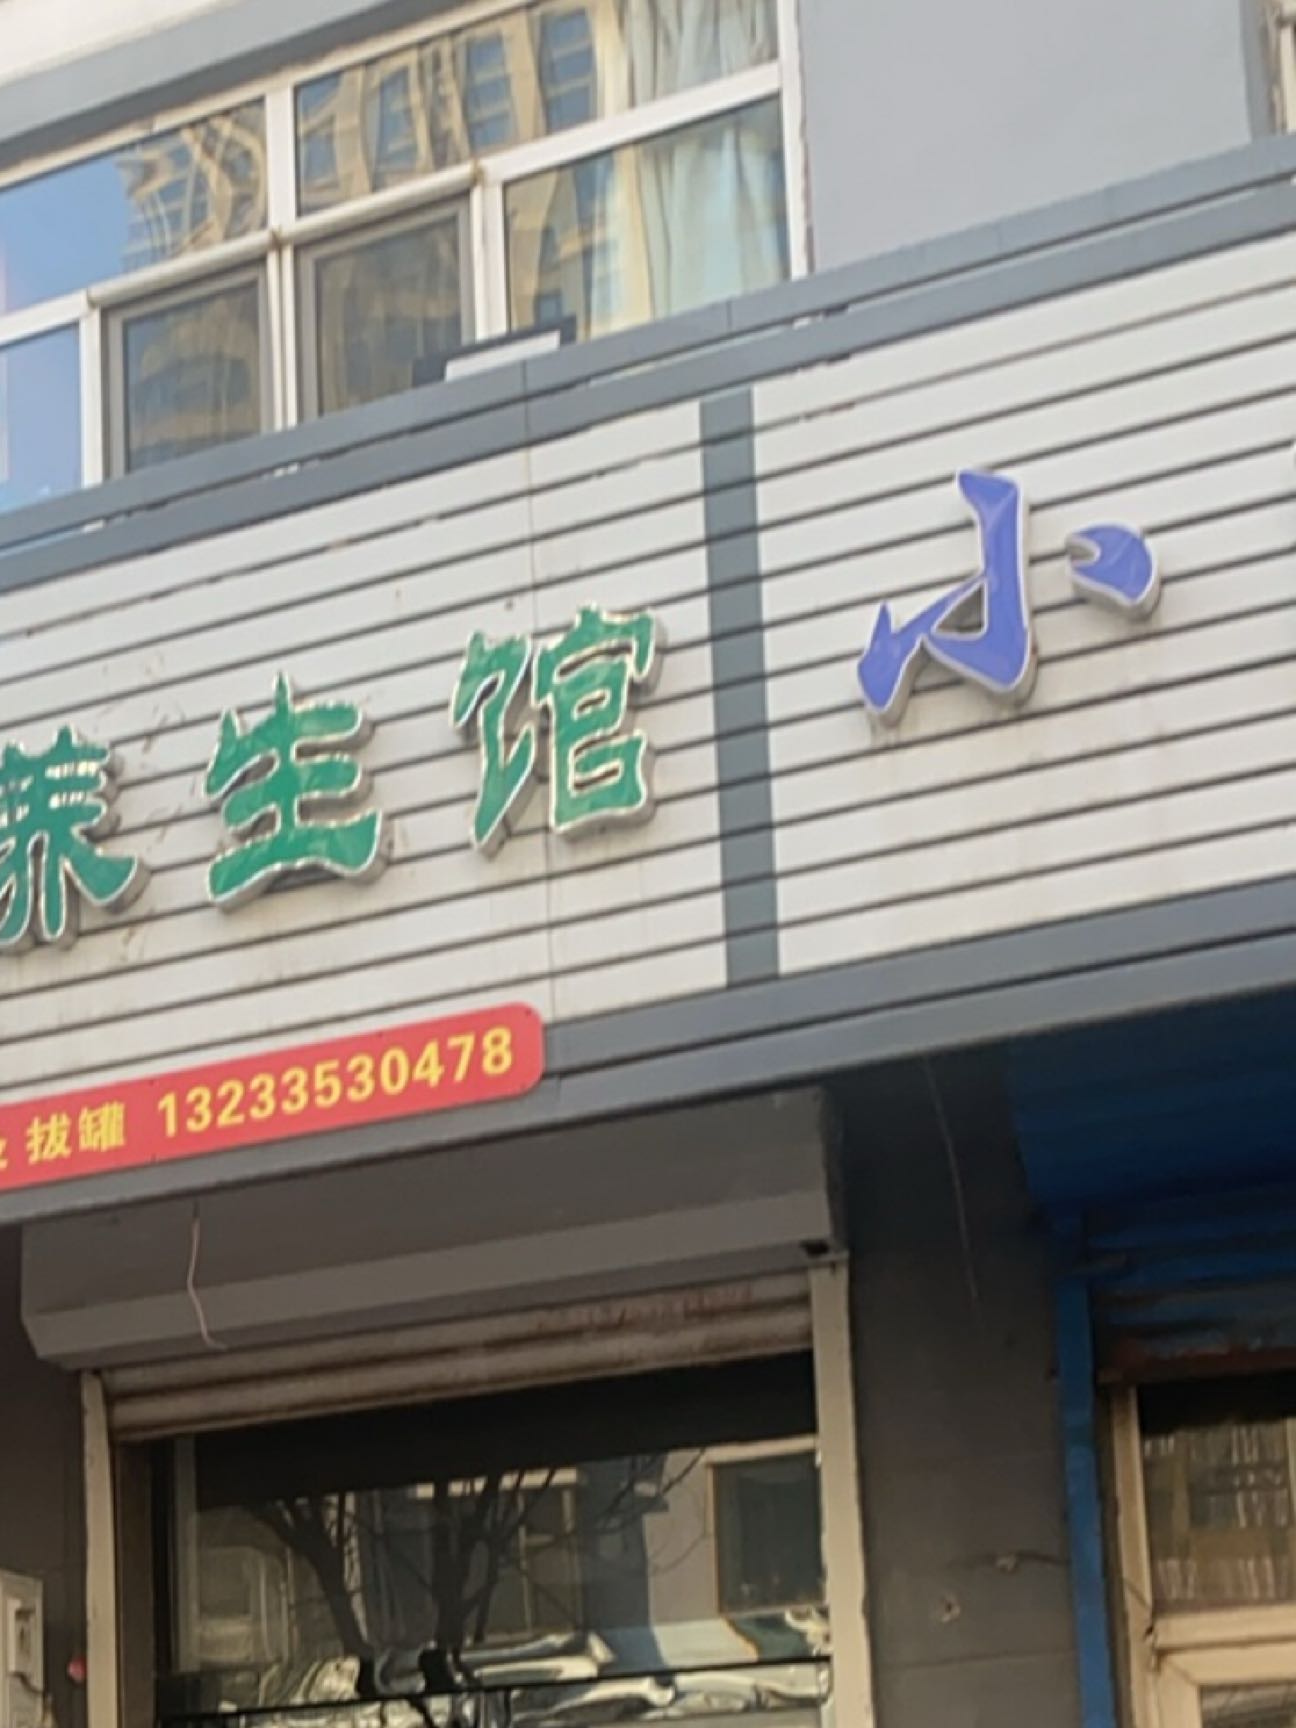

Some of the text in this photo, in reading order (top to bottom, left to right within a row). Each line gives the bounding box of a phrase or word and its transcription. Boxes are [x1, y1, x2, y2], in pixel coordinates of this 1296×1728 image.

[857, 467, 1161, 726] 小
[25, 1100, 127, 1166] 拔罐
[157, 1026, 514, 1139] 13233530478
